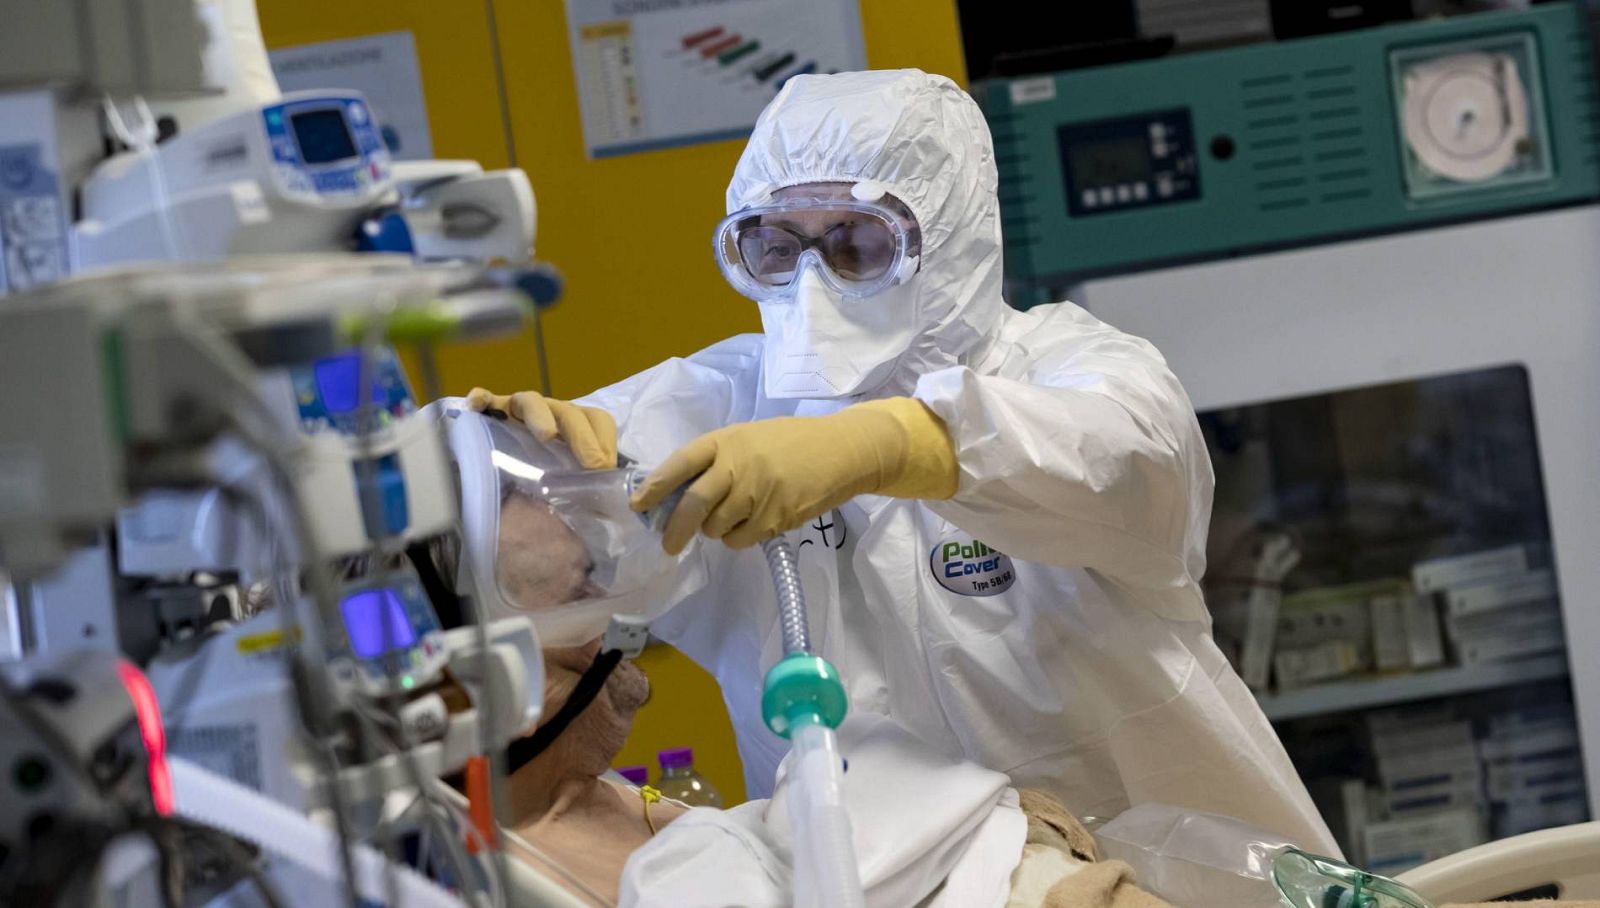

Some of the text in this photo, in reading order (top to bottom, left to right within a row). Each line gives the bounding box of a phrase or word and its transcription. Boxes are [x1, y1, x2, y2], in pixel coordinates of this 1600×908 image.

[943, 540, 999, 562] Poli
[945, 556, 1000, 577] Cover
[972, 581, 989, 592] Type
